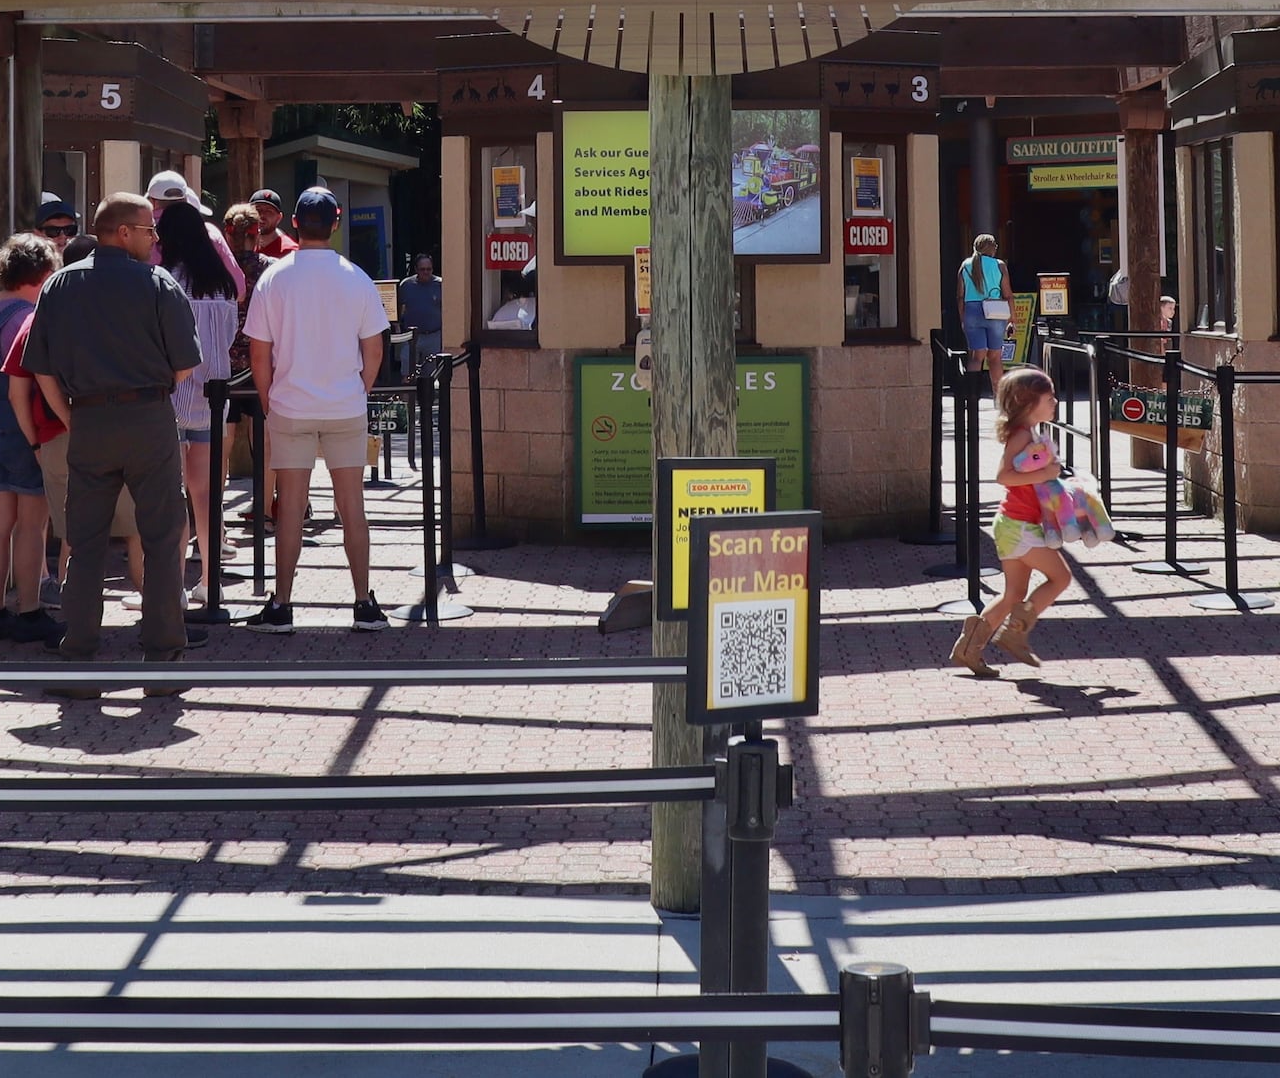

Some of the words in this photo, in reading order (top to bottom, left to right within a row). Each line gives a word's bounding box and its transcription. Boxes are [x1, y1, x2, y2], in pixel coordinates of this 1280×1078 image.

[528, 74, 546, 100] 4
[911, 75, 929, 102] 3
[101, 83, 121, 109] 5
[574, 148, 597, 158] Ask
[600, 149, 621, 157] our
[625, 148, 649, 157] Gue
[1013, 142, 1058, 157] SAFARI
[1061, 140, 1117, 155] OUTFITT
[574, 167, 625, 177] Services
[1033, 174, 1058, 182] Stroller
[1066, 172, 1104, 180] Wheelchair
[575, 187, 611, 196] about
[615, 186, 648, 196] Rides
[575, 206, 598, 216] and
[849, 226, 888, 246] CLOSED
[491, 241, 529, 262] CLOSED
[371, 410, 398, 418] LINE
[1147, 400, 1167, 410] THI
[1177, 404, 1203, 413] LINE
[709, 533, 762, 557] Scan
[771, 529, 808, 553] for
[709, 577, 746, 594] our
[754, 570, 804, 593] Map
